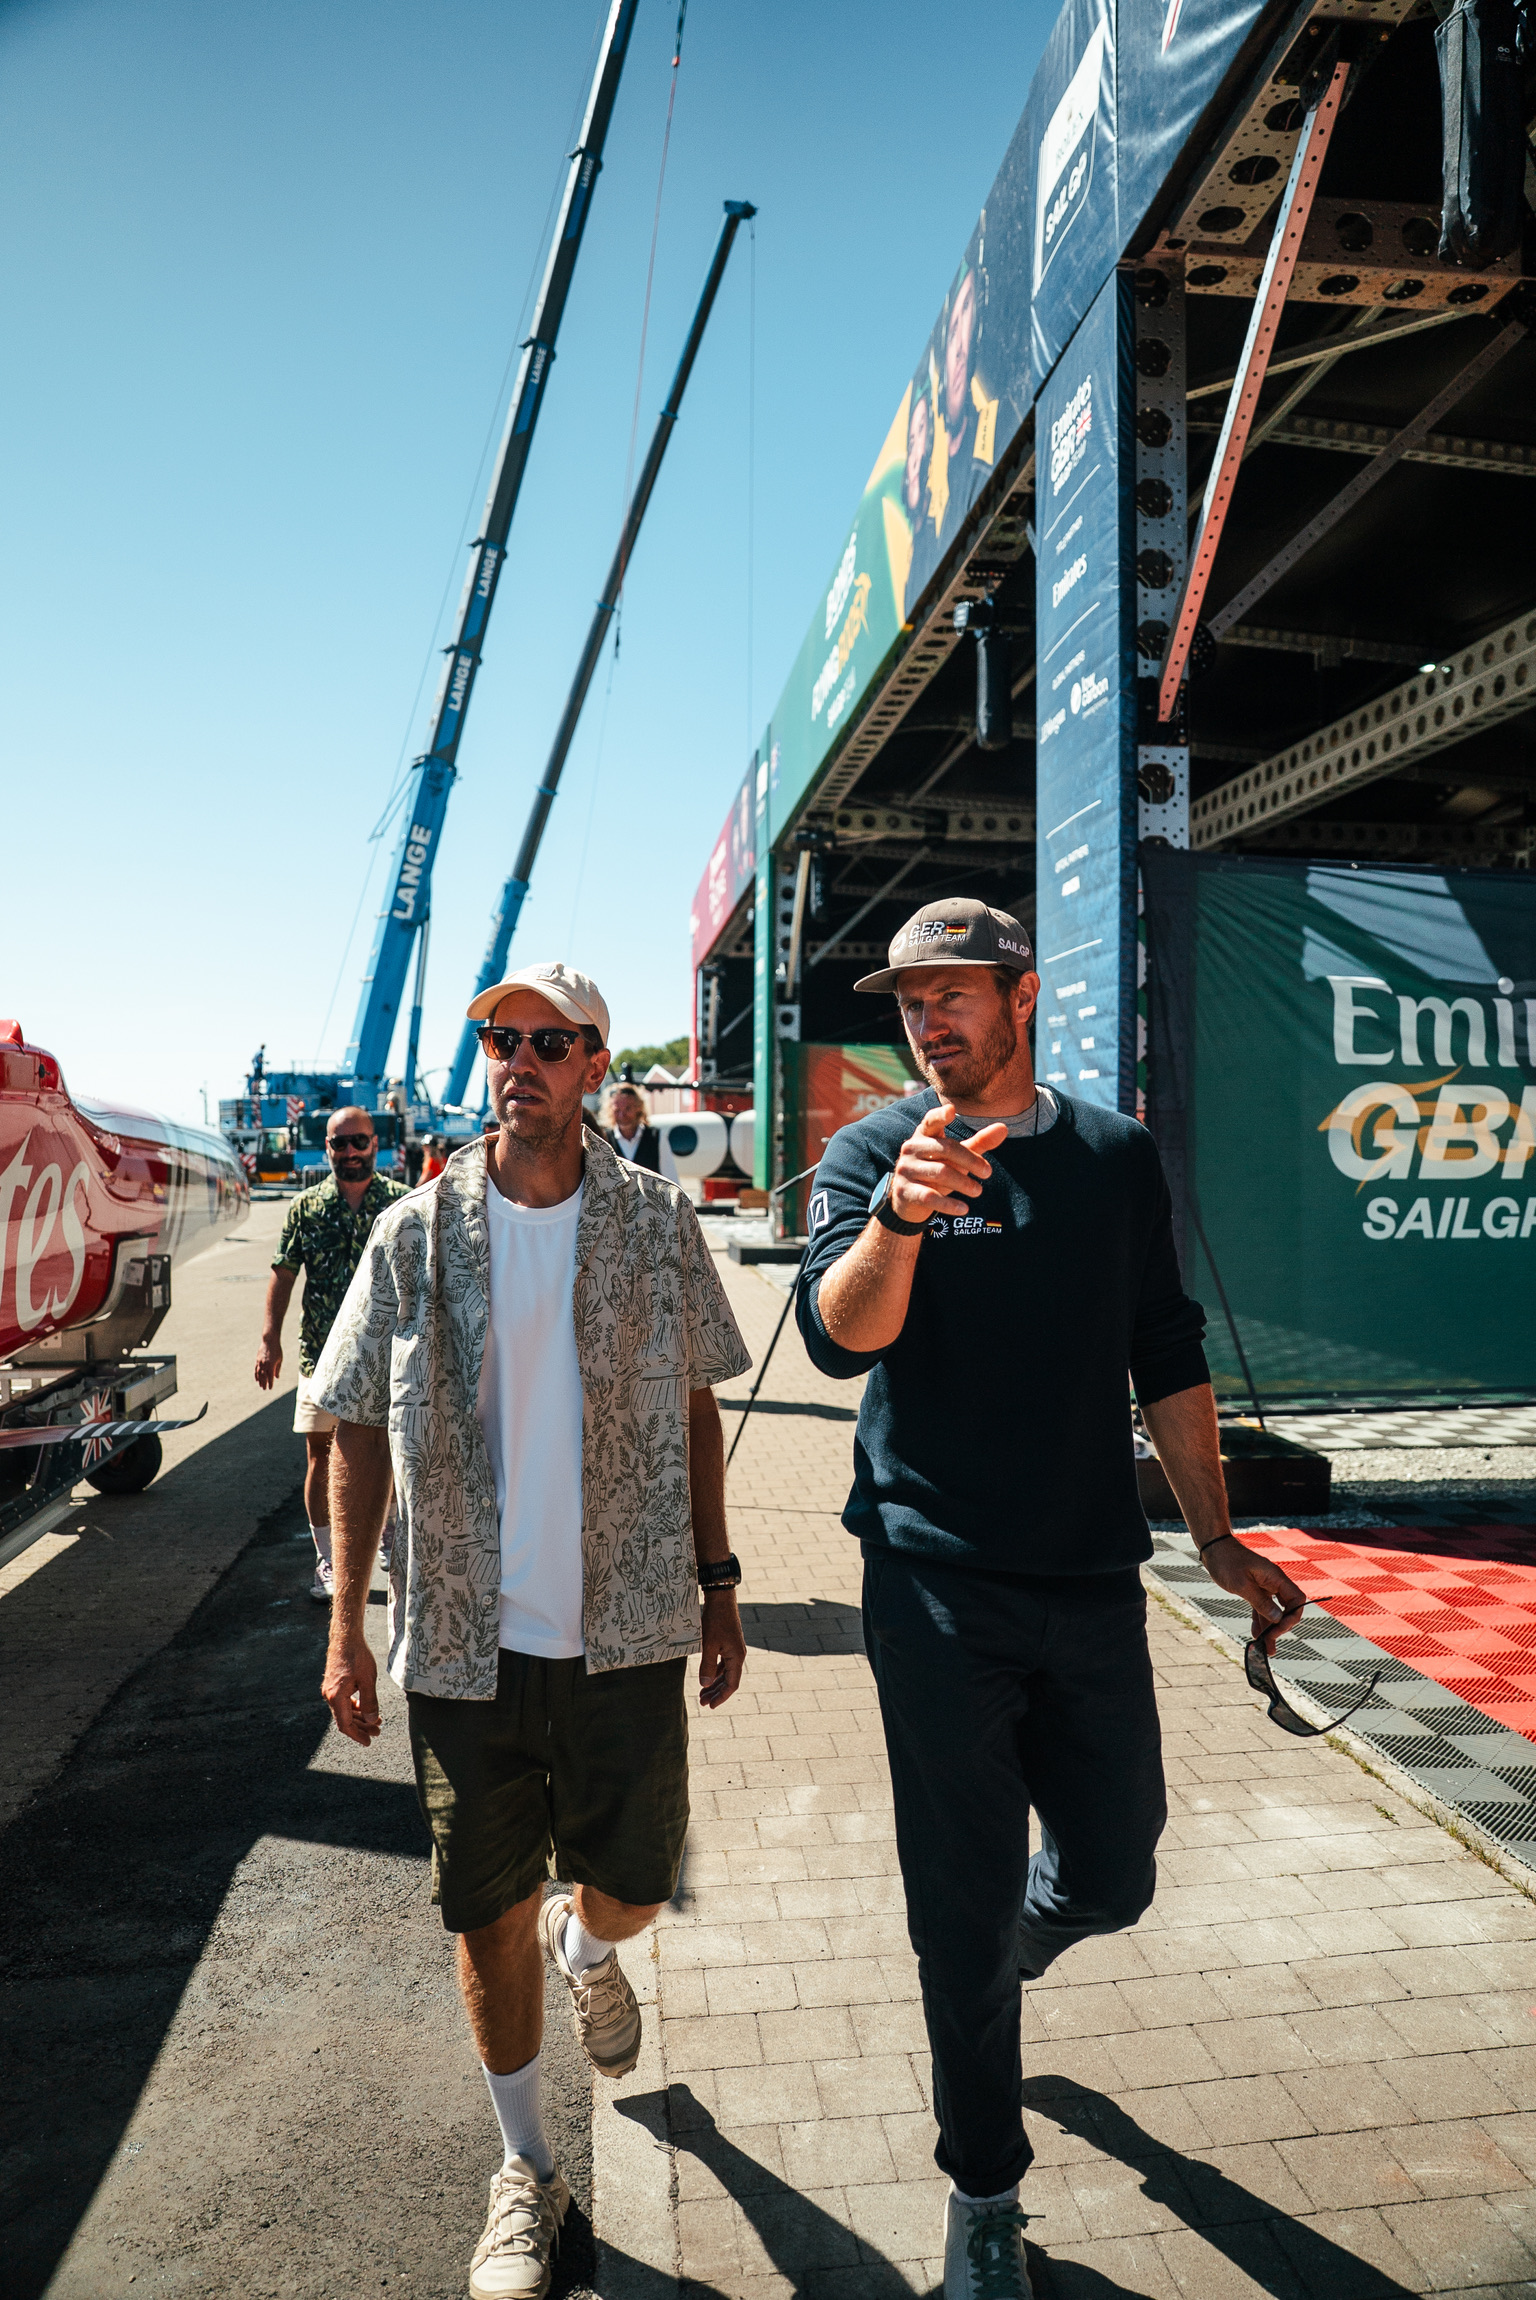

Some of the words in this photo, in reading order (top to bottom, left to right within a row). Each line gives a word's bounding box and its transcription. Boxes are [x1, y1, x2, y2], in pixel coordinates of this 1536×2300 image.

[529, 346, 548, 385] LANGE
[477, 547, 499, 598] LANGE
[448, 655, 473, 712] LANGE
[392, 823, 433, 920] LANGE
[908, 921, 946, 940] GER
[908, 935, 938, 948] SAILGP
[940, 933, 967, 942] TEAM
[998, 937, 1030, 958] SAILGP
[953, 1217, 984, 1229] GER
[953, 1228, 982, 1236] SAILGP
[982, 1226, 1003, 1234] TEAM
